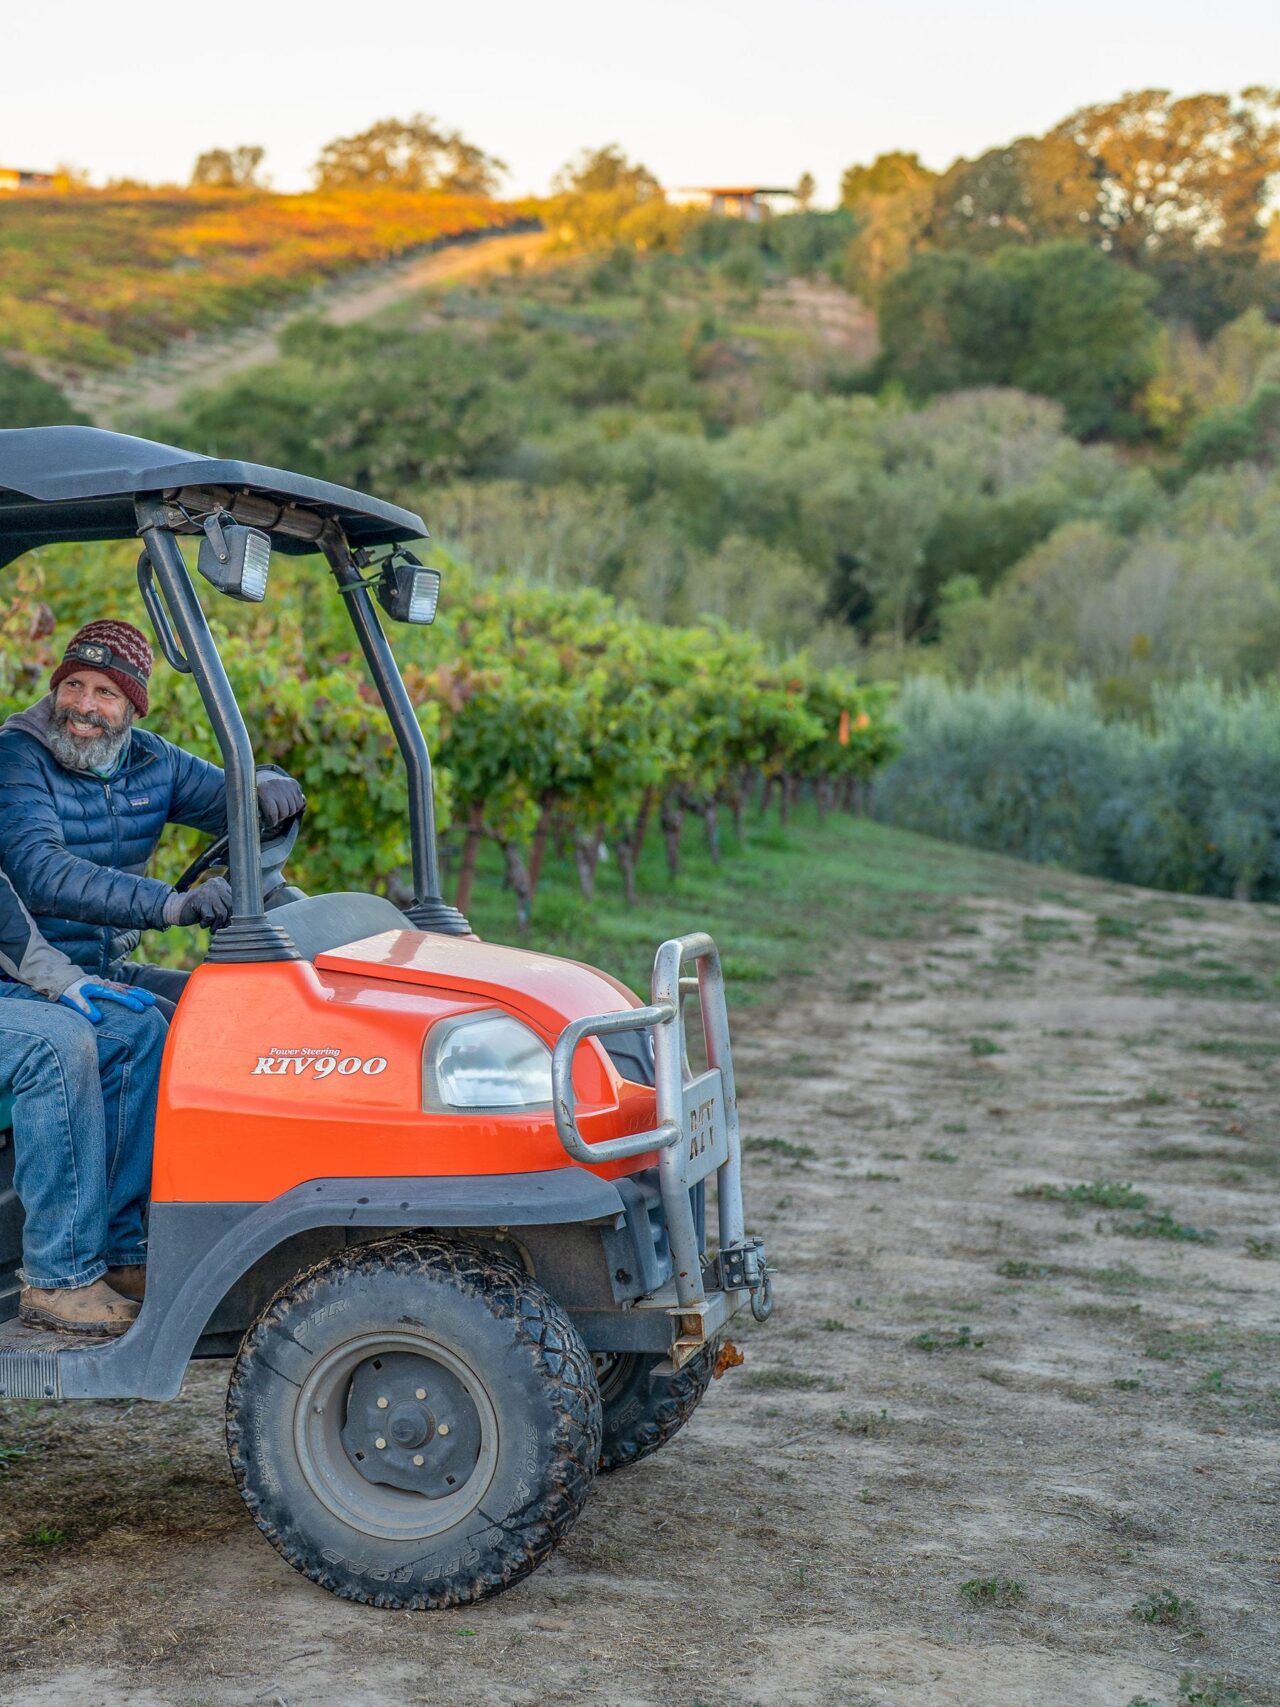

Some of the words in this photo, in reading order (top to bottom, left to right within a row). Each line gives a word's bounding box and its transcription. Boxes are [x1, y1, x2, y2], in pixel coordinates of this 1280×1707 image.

[249, 1056, 388, 1080] RTV900
[269, 1047, 300, 1056] Power
[300, 1047, 341, 1057] Steering
[293, 1298, 346, 1341] OTR
[321, 1549, 414, 1583] ROAD
[422, 1549, 480, 1582] OFF
